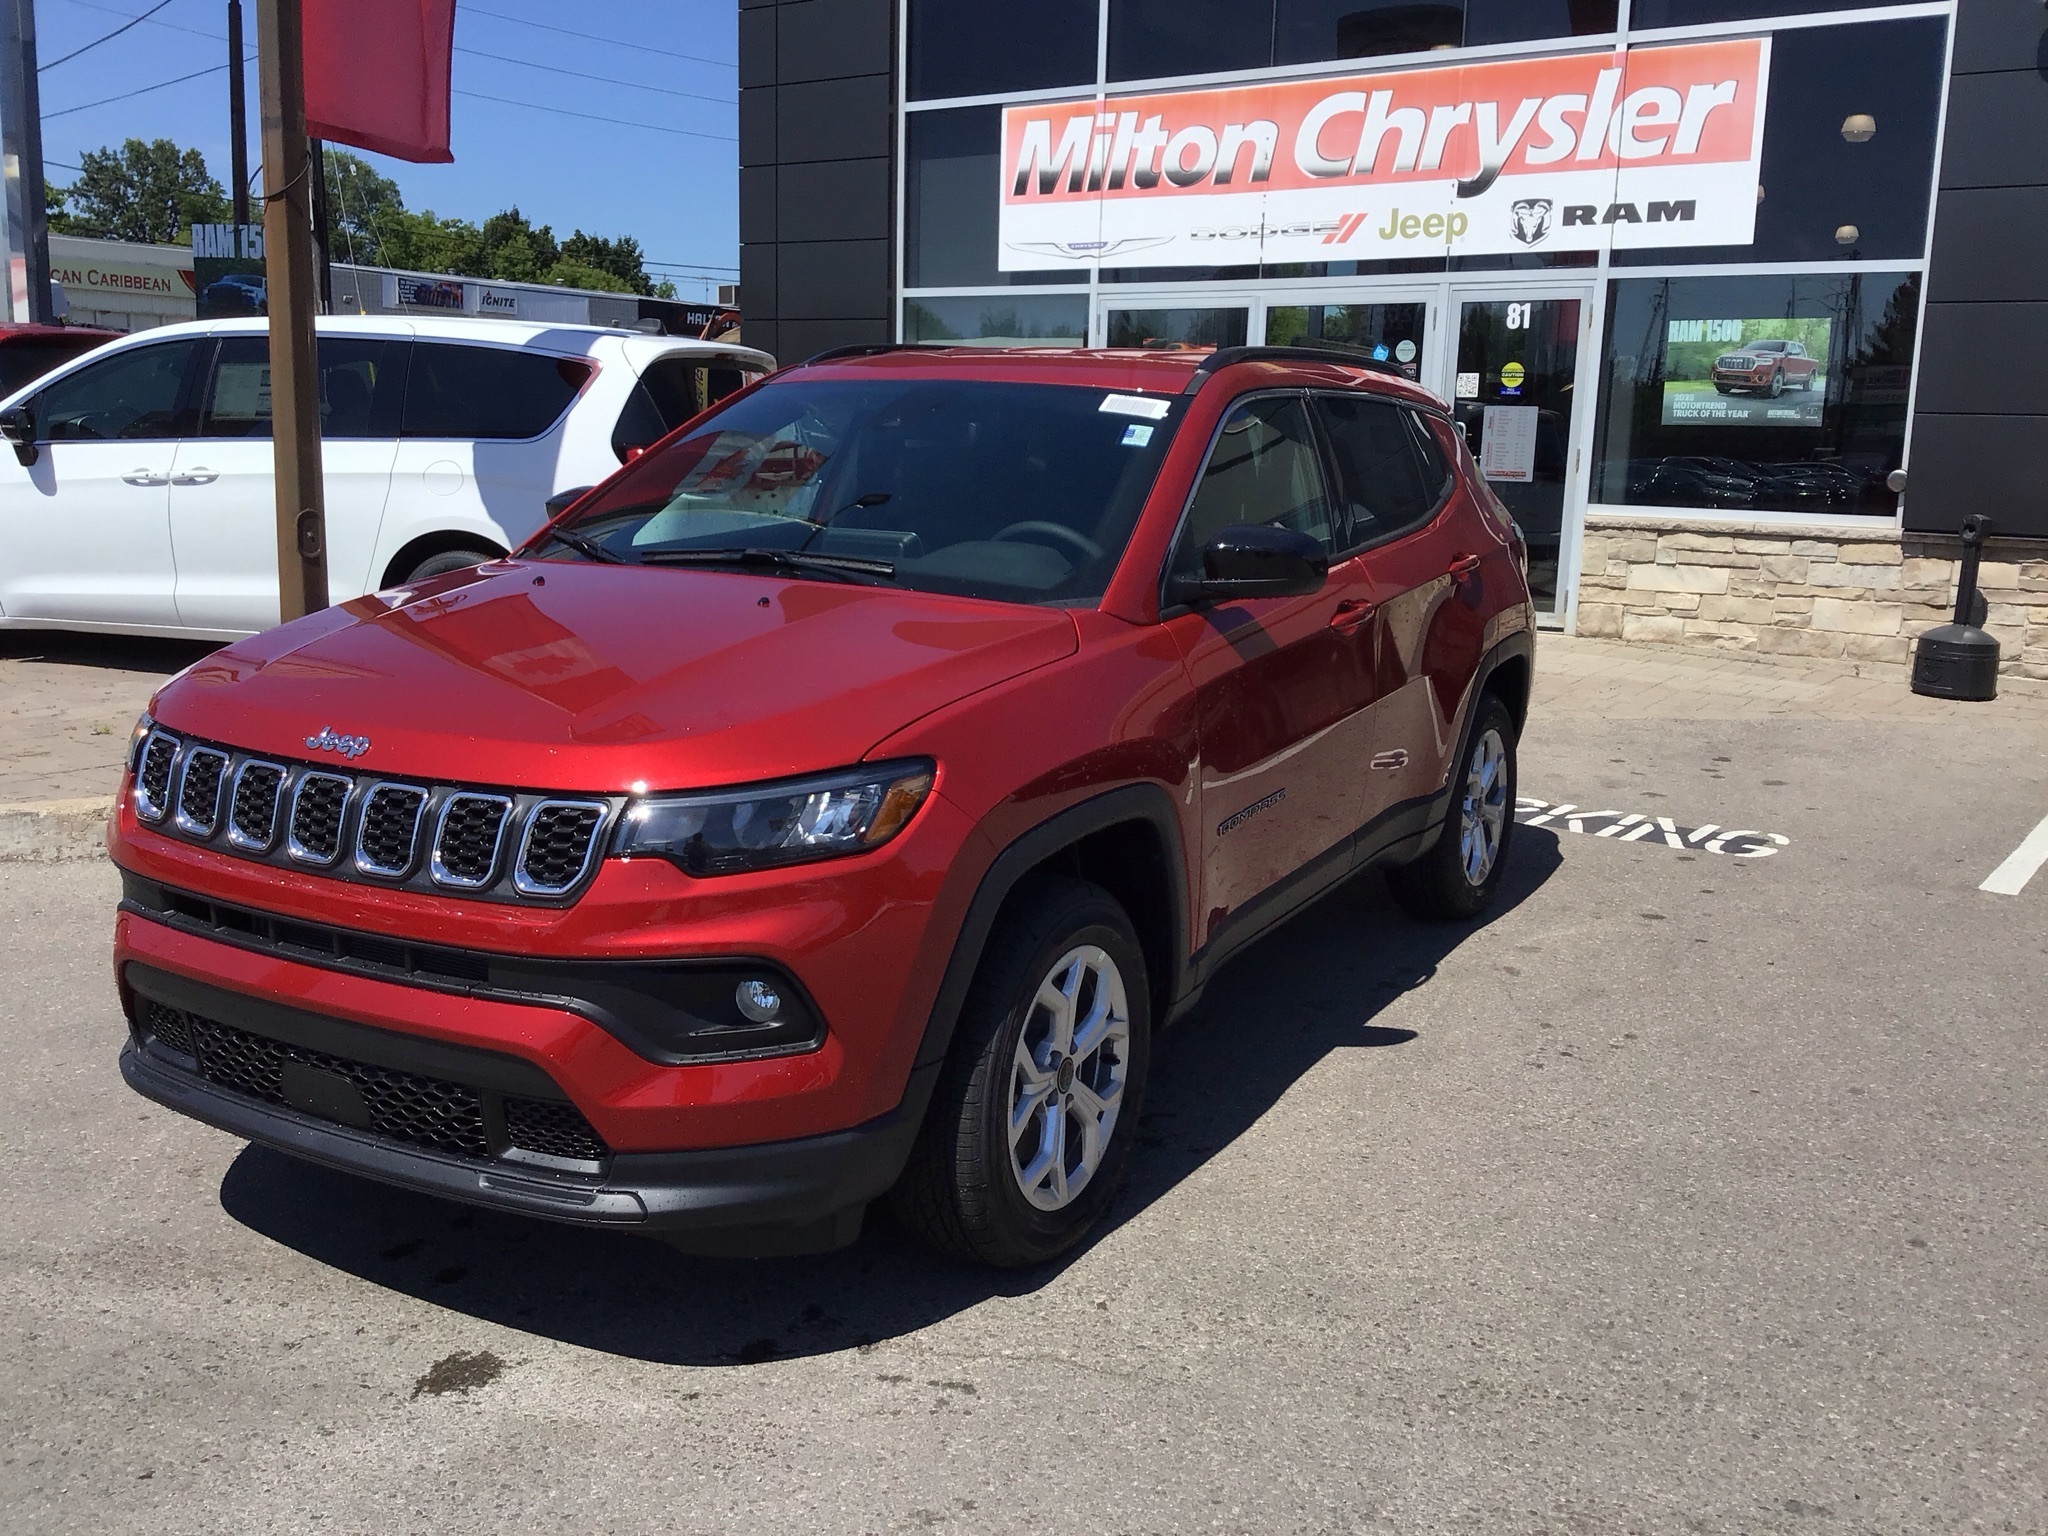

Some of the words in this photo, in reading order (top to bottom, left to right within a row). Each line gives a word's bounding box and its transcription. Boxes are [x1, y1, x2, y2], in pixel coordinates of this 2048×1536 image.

[1013, 110, 1280, 197] Milton
[1294, 67, 1739, 198] Chrysler
[1379, 207, 1468, 244] Jeep
[1562, 199, 1697, 227] RAM
[191, 223, 235, 259] RAM
[238, 223, 267, 260] 15
[1190, 220, 1341, 242] DODGE
[87, 270, 171, 292] CARIBBEAN
[481, 295, 516, 308] IGNITE
[1506, 302, 1532, 330] 81
[1668, 320, 1704, 343] RAM
[1706, 319, 1743, 343] 1500
[1673, 401, 1727, 409] MOTORTREND
[1674, 393, 1695, 401] 2025
[1673, 409, 1699, 417] TRUCK
[1712, 410, 1726, 418] THE
[305, 725, 370, 760] Jeep
[1218, 788, 1287, 836] COMPASS
